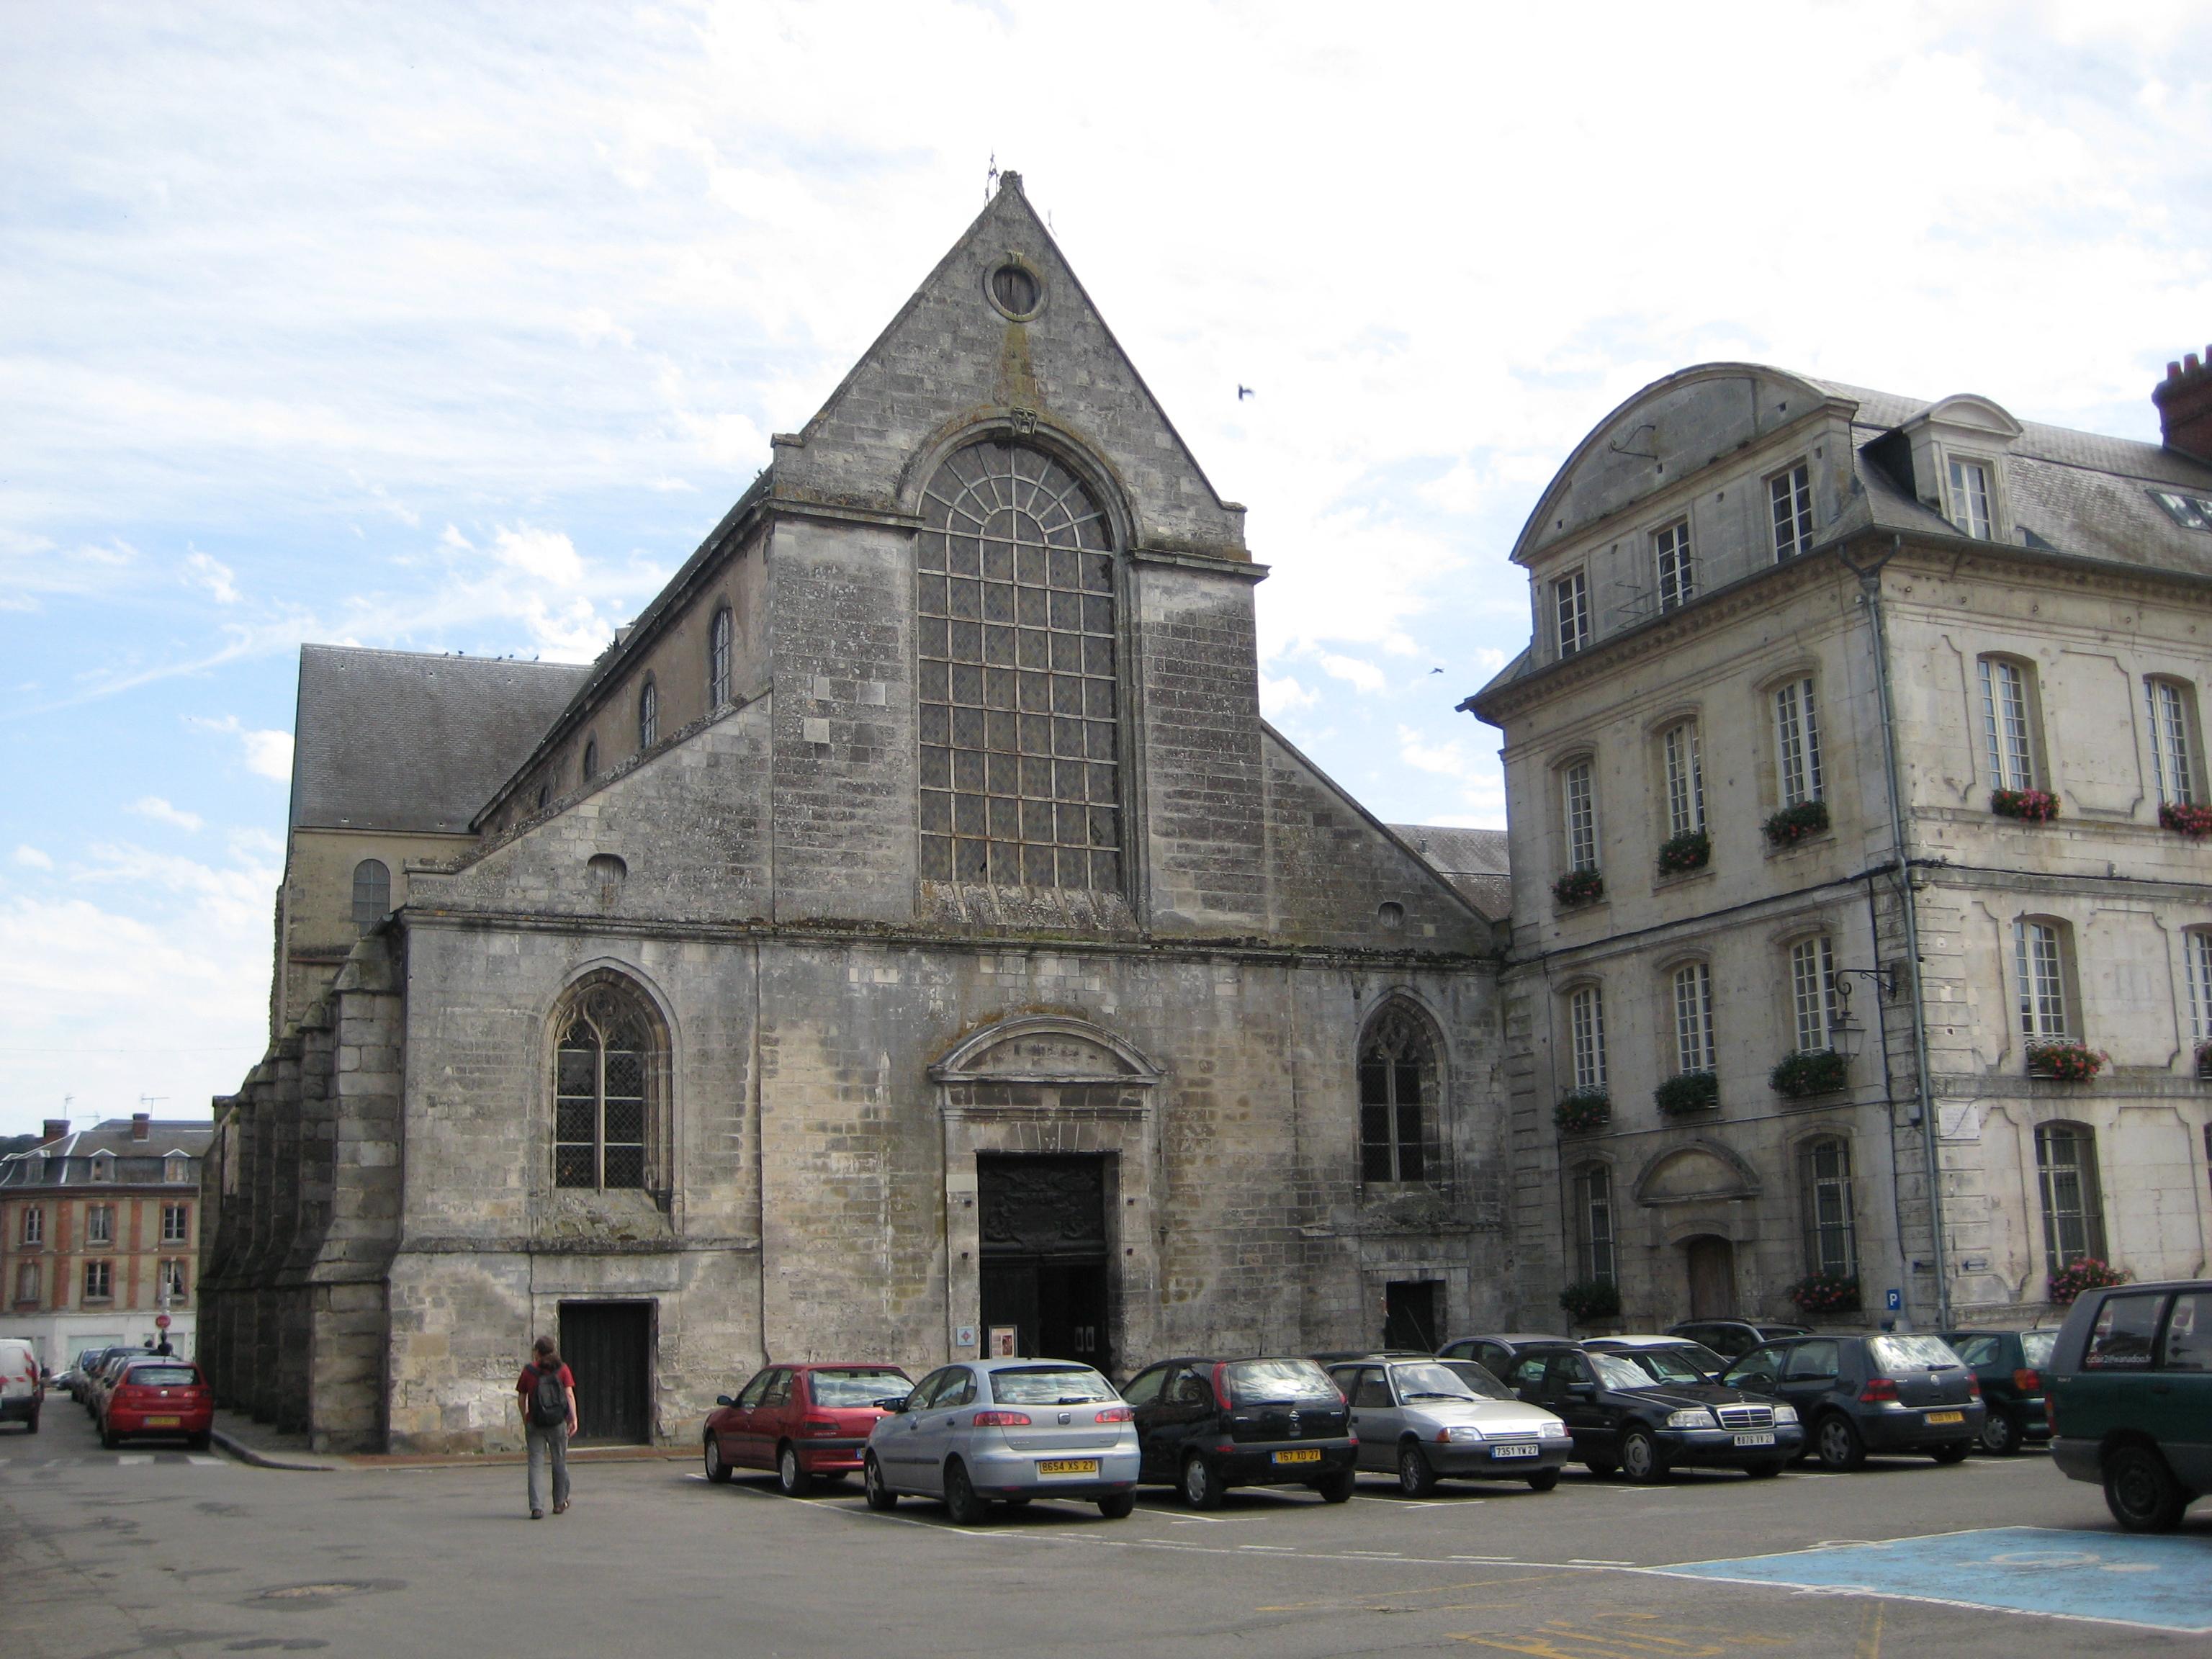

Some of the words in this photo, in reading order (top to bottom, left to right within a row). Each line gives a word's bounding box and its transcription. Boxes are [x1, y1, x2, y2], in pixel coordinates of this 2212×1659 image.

[1889, 1293, 1898, 1305] P
[1279, 1451, 1292, 1461] 167
[1309, 1450, 1318, 1460] 27
[1496, 1447, 1515, 1456] 7351
[1528, 1446, 1537, 1455] 27
[1042, 1462, 1064, 1471] 8654
[1068, 1461, 1079, 1470] XS
[1083, 1461, 1093, 1470] 27
